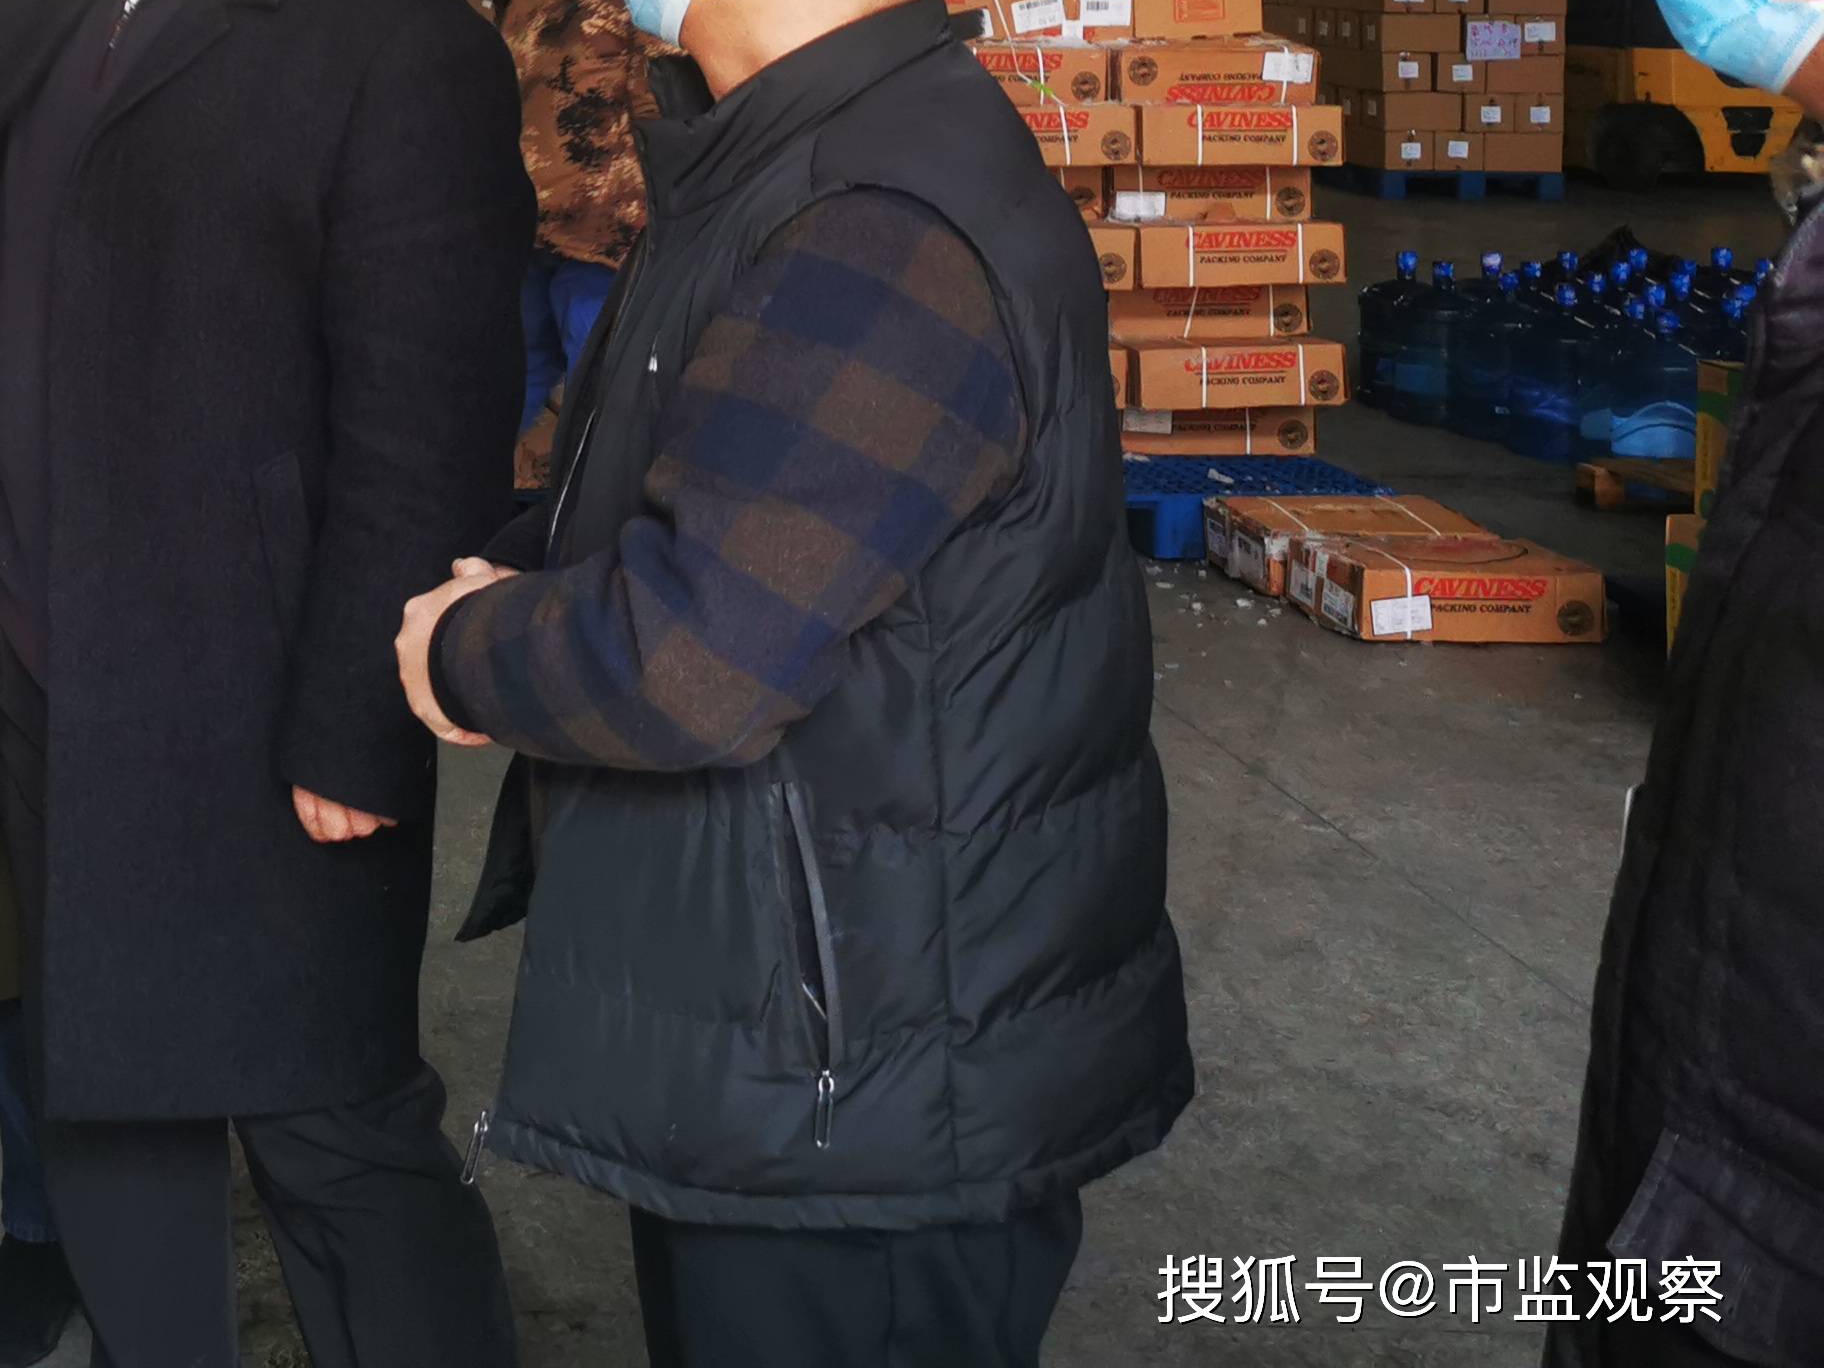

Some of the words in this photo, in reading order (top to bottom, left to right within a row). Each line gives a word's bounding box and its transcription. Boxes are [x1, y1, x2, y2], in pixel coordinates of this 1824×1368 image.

[978, 52, 1063, 71] VINESS
[1024, 111, 1090, 130] NESS
[1185, 231, 1298, 249] CAVINESS
[1199, 254, 1240, 264] PACKING
[1243, 254, 1287, 264] COMPANY
[1242, 375, 1286, 385] COMPANY
[1413, 576, 1551, 599] CAVINESS
[1431, 603, 1476, 614] PACKING
[1479, 603, 1532, 614] COMPANY
